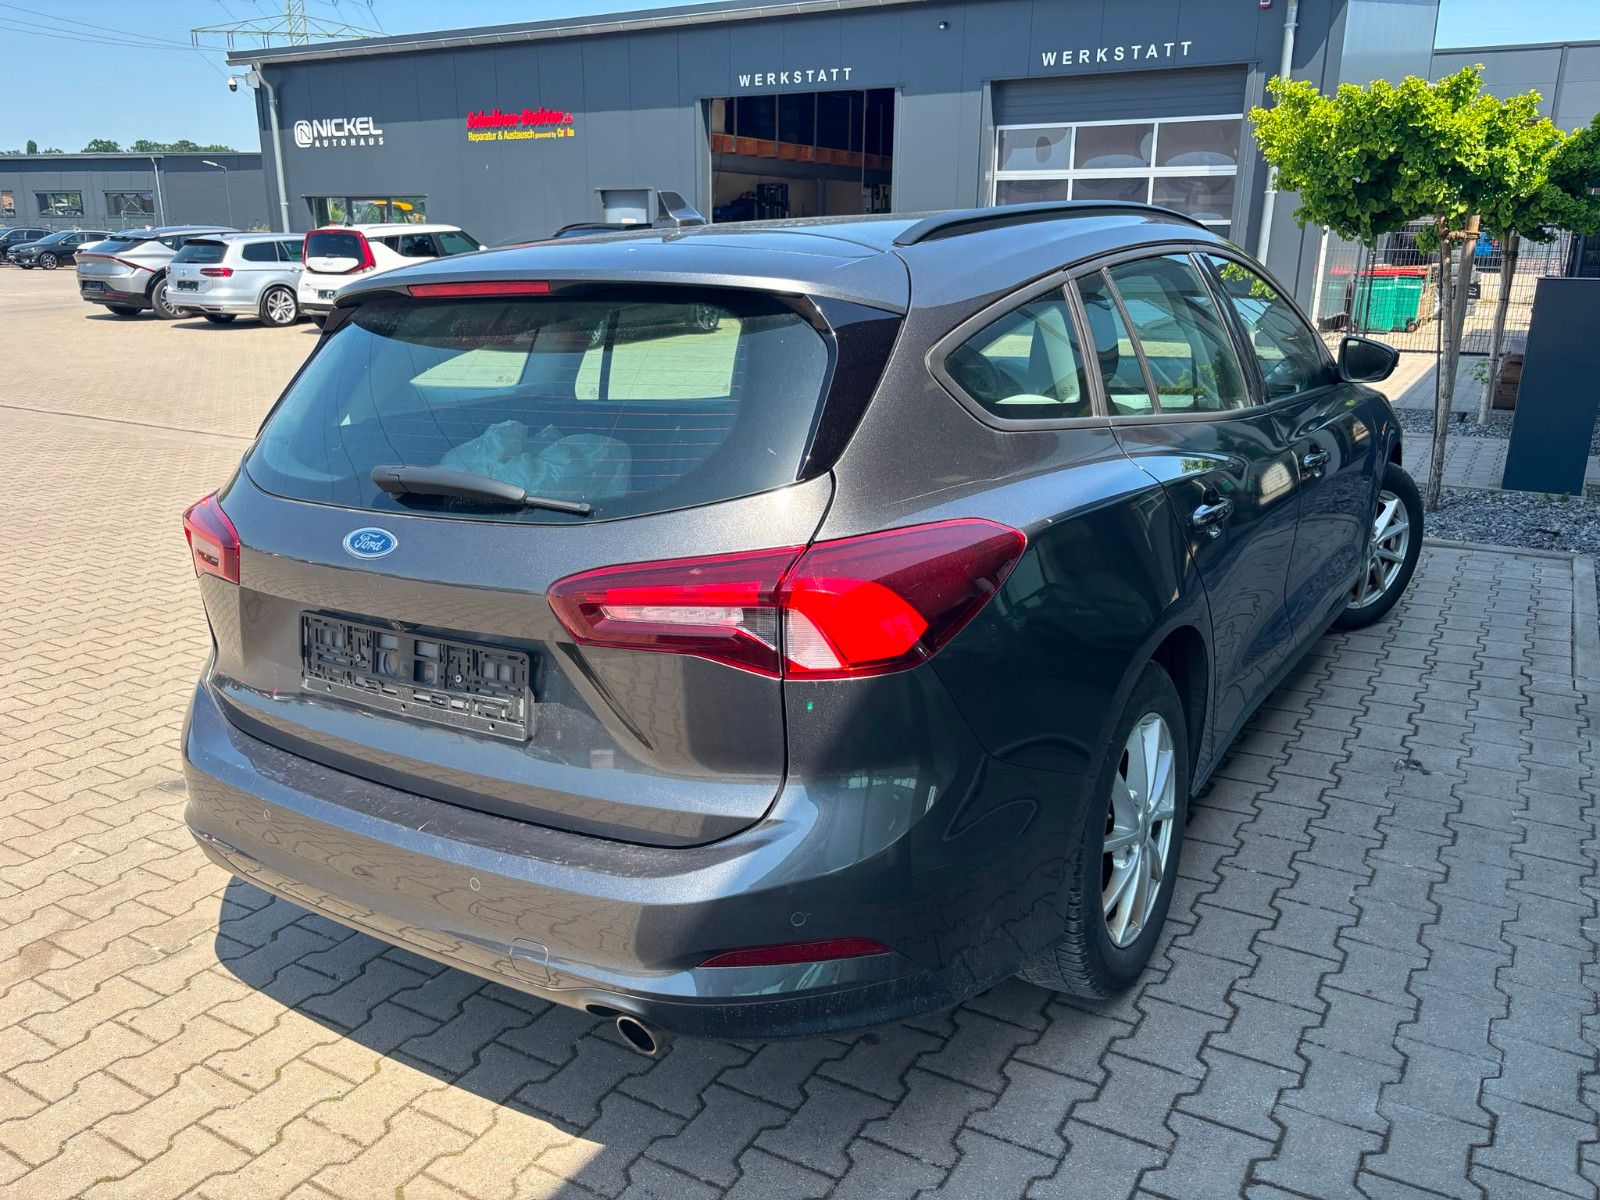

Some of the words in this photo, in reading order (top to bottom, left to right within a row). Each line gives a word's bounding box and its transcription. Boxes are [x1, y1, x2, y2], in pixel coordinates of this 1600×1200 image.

[1042, 41, 1192, 67] WERKSTATT
[739, 67, 852, 87] WERKSTATT
[313, 117, 383, 137] NICKEL
[468, 131, 498, 142] Reparatur
[498, 131, 503, 140] &
[504, 129, 535, 140] Austausch
[315, 137, 384, 147] AUTOHAUS
[354, 533, 385, 551] Ford
